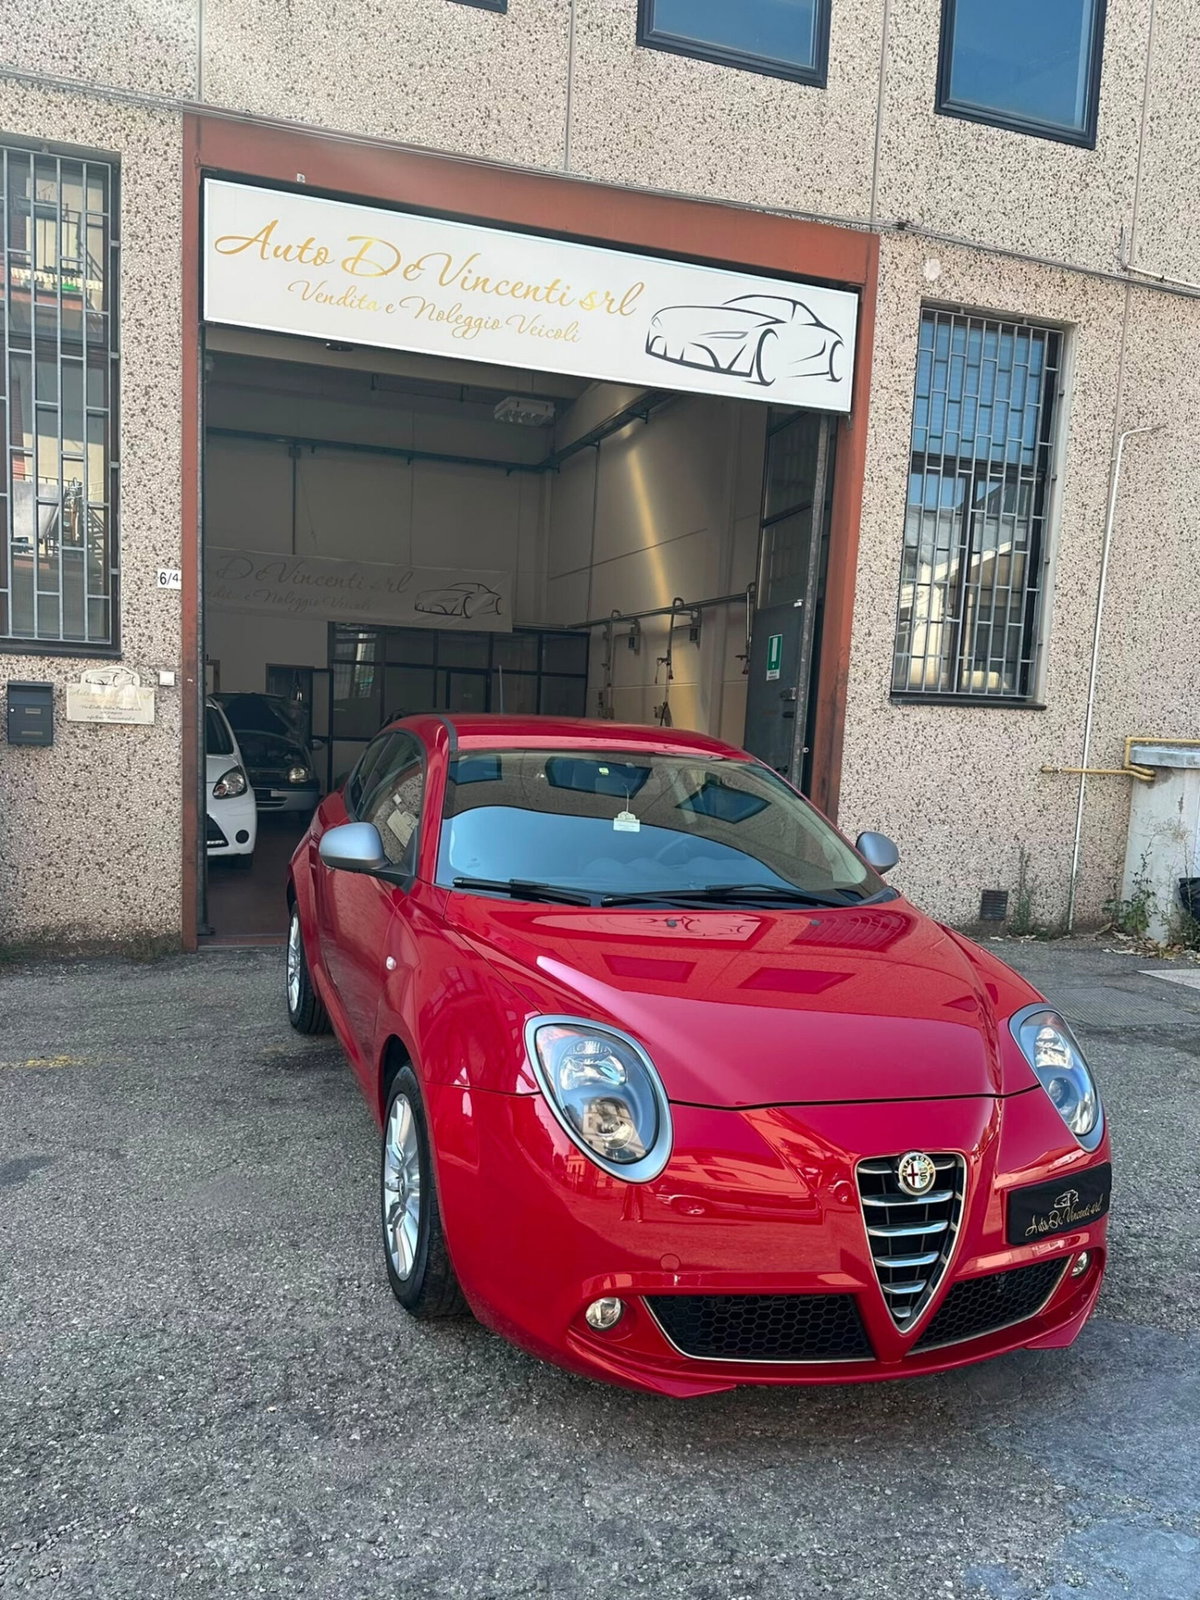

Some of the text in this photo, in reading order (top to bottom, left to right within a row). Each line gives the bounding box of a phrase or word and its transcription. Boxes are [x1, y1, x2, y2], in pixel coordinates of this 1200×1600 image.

[214, 219, 335, 267] Auto
[579, 281, 645, 316] srl
[287, 280, 581, 343] Vendita e Noleggio Veicoli
[159, 571, 179, 585] 6/4
